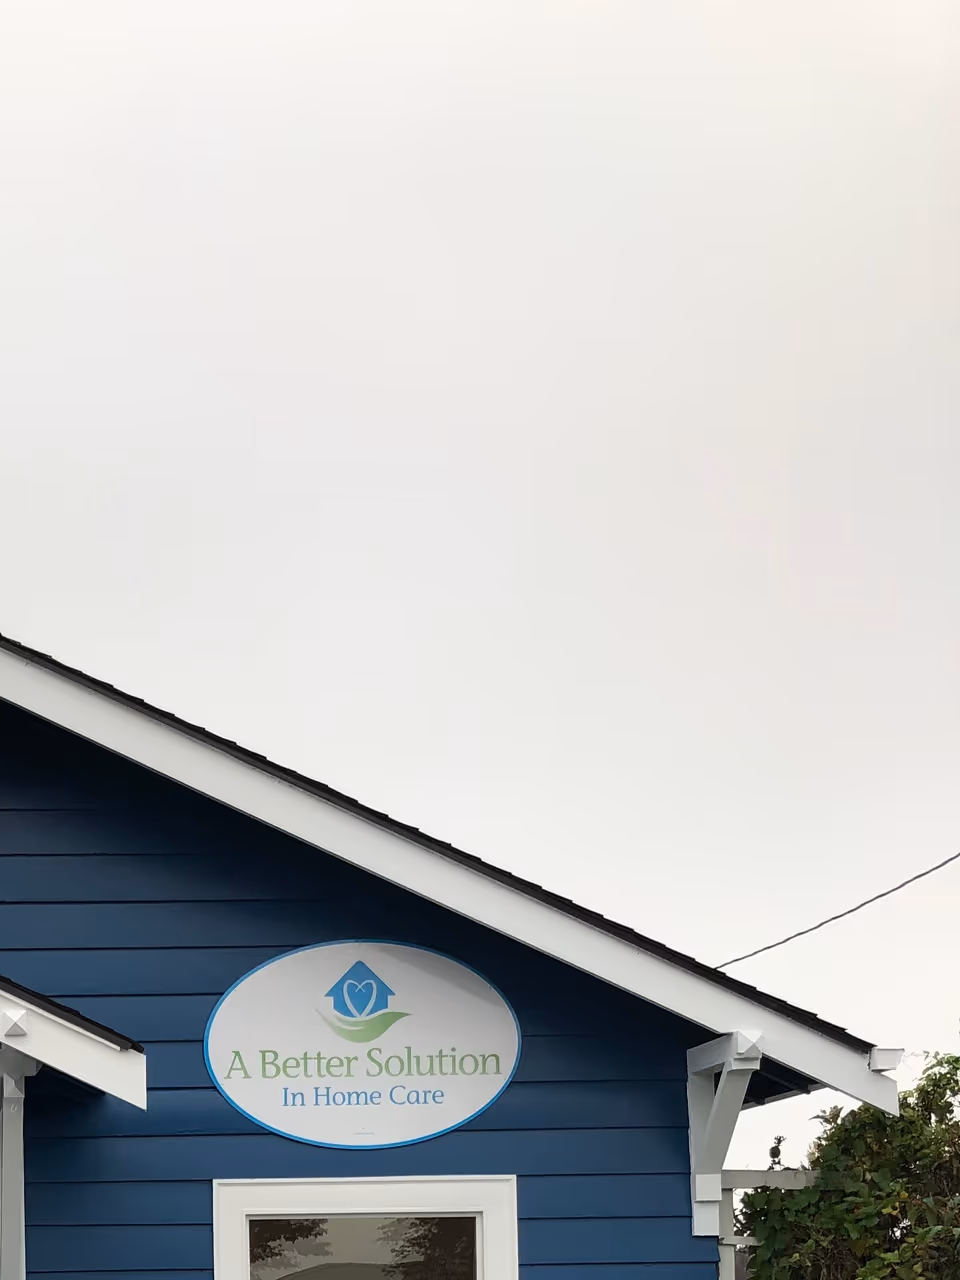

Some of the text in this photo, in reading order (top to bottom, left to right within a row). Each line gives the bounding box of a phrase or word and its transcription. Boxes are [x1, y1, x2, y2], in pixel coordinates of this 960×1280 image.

[223, 1046, 502, 1080] A Better Solution
[281, 1085, 445, 1107] In Home Care
